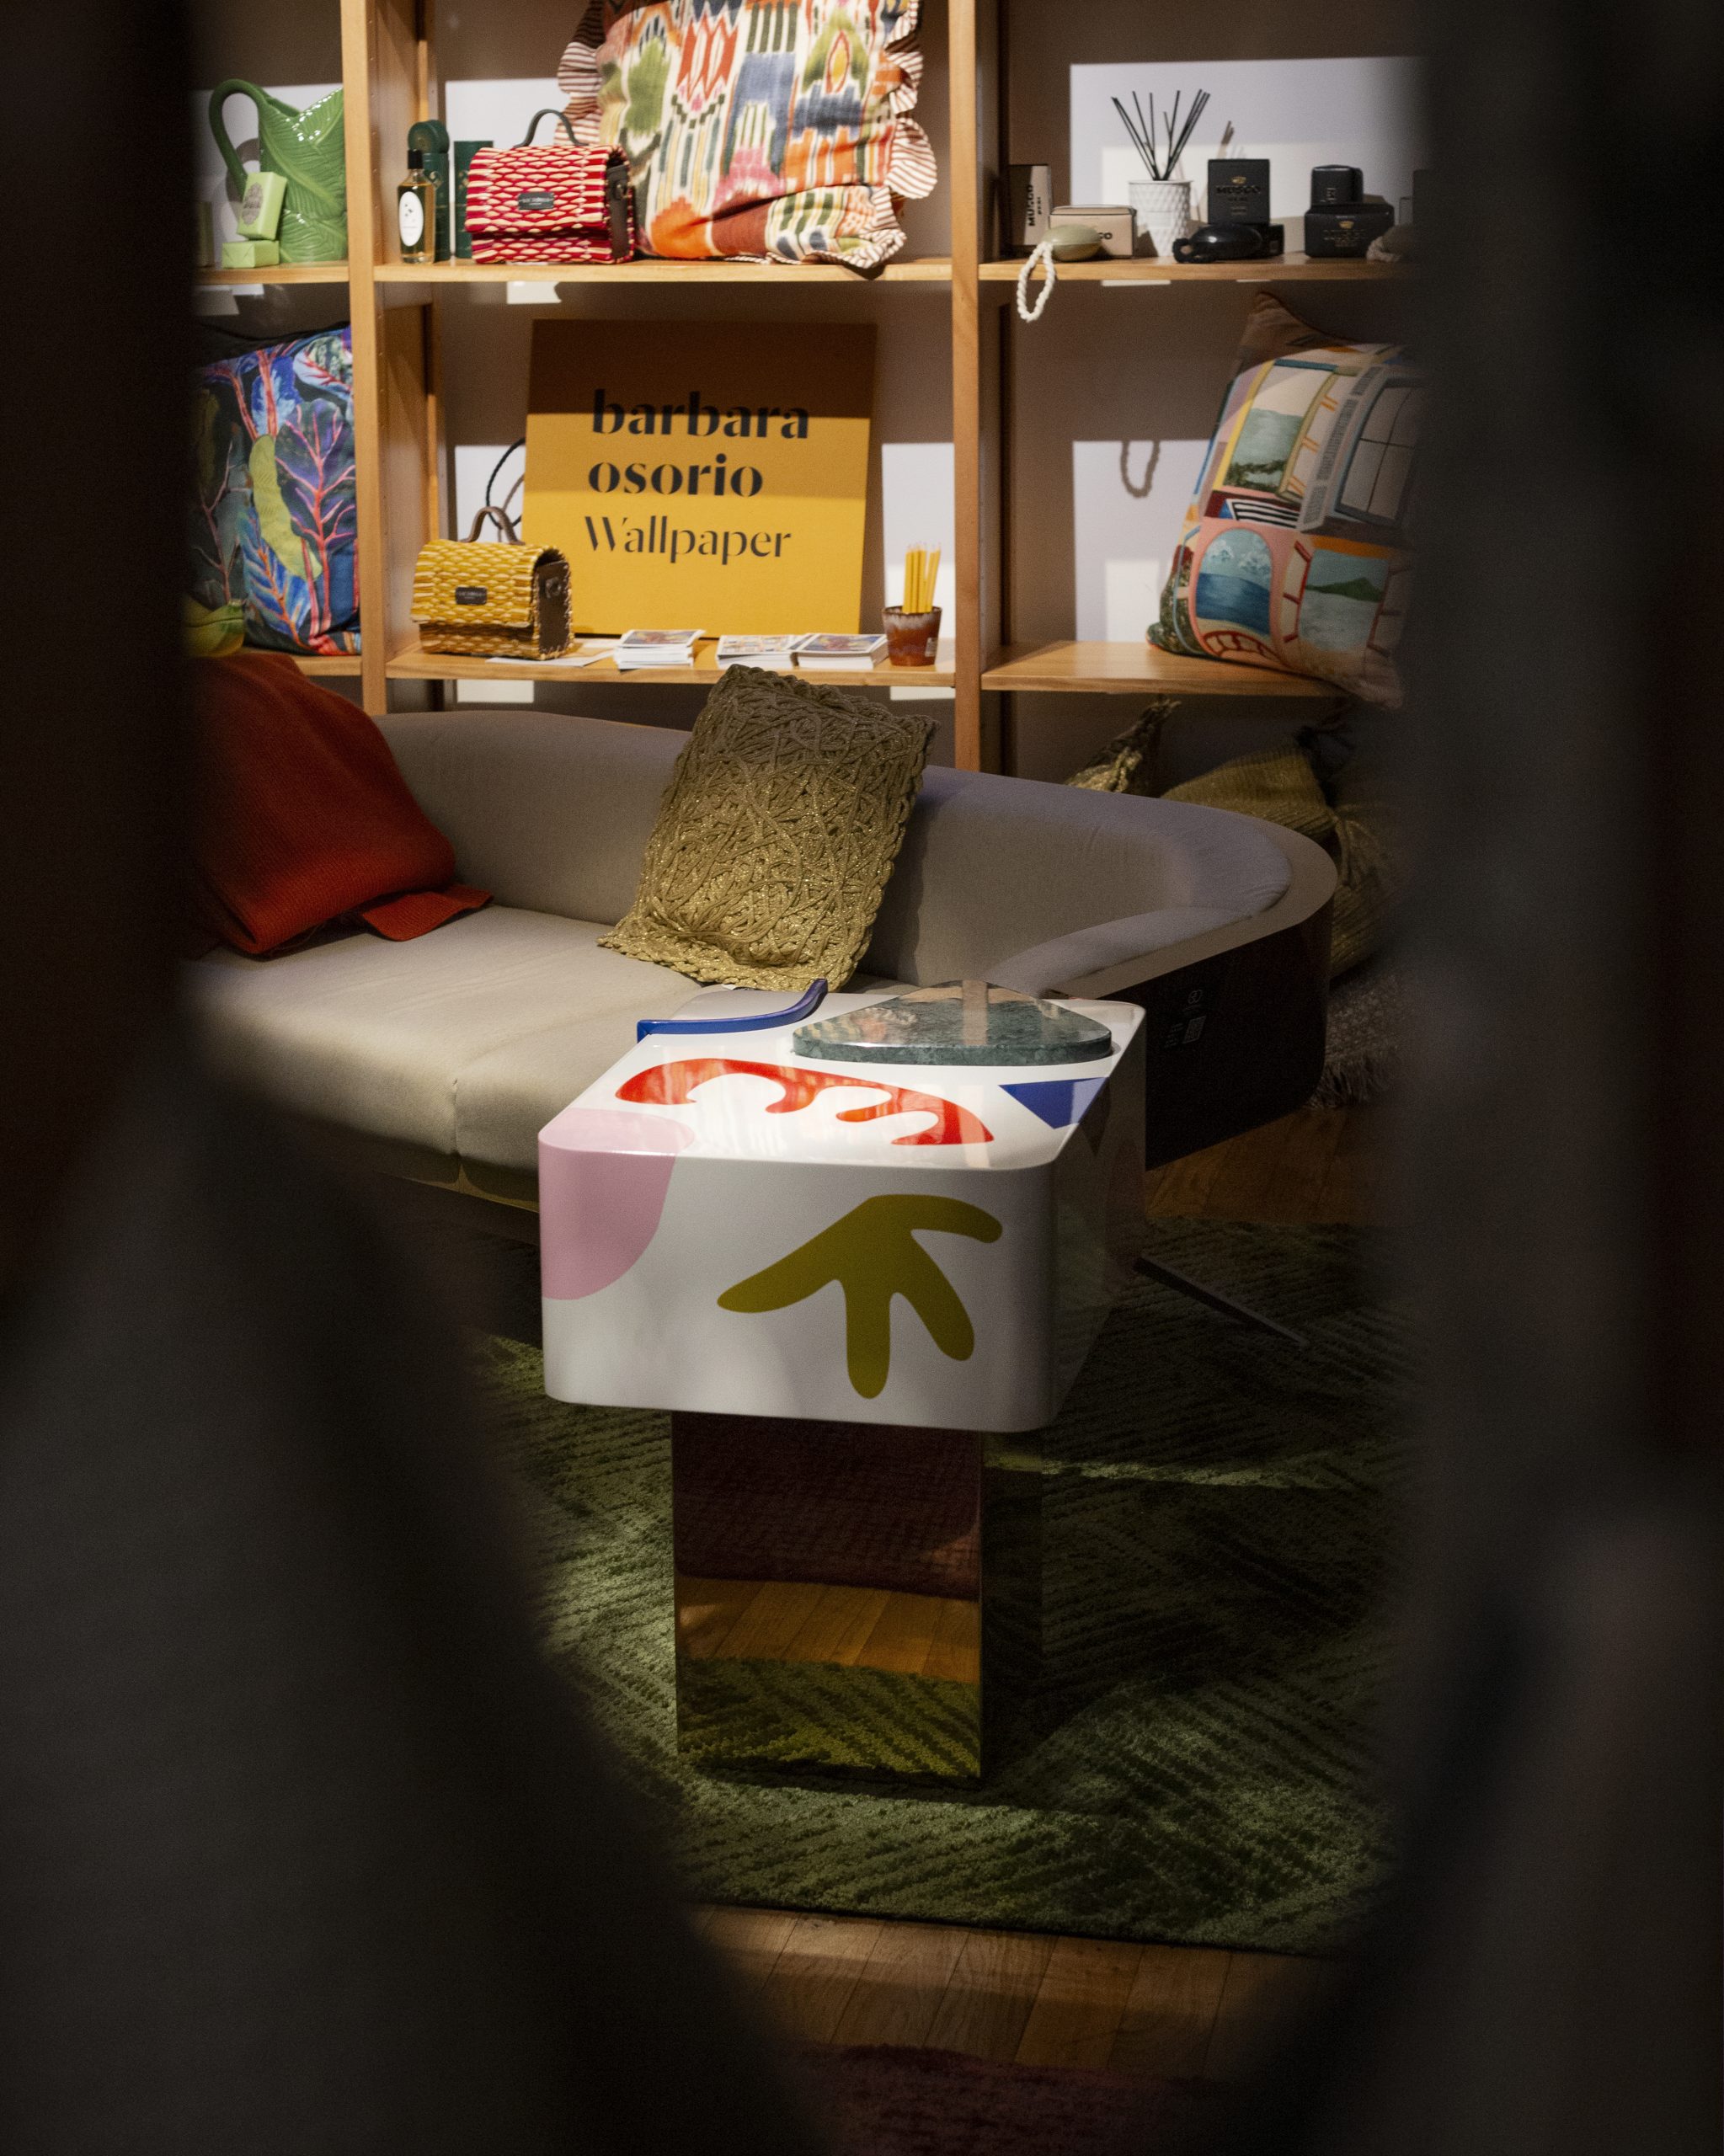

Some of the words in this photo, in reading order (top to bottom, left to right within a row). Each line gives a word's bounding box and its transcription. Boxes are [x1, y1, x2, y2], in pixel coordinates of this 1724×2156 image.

[592, 388, 809, 439] barbara
[588, 453, 763, 498] osorio
[584, 515, 792, 565] Wallpaper
